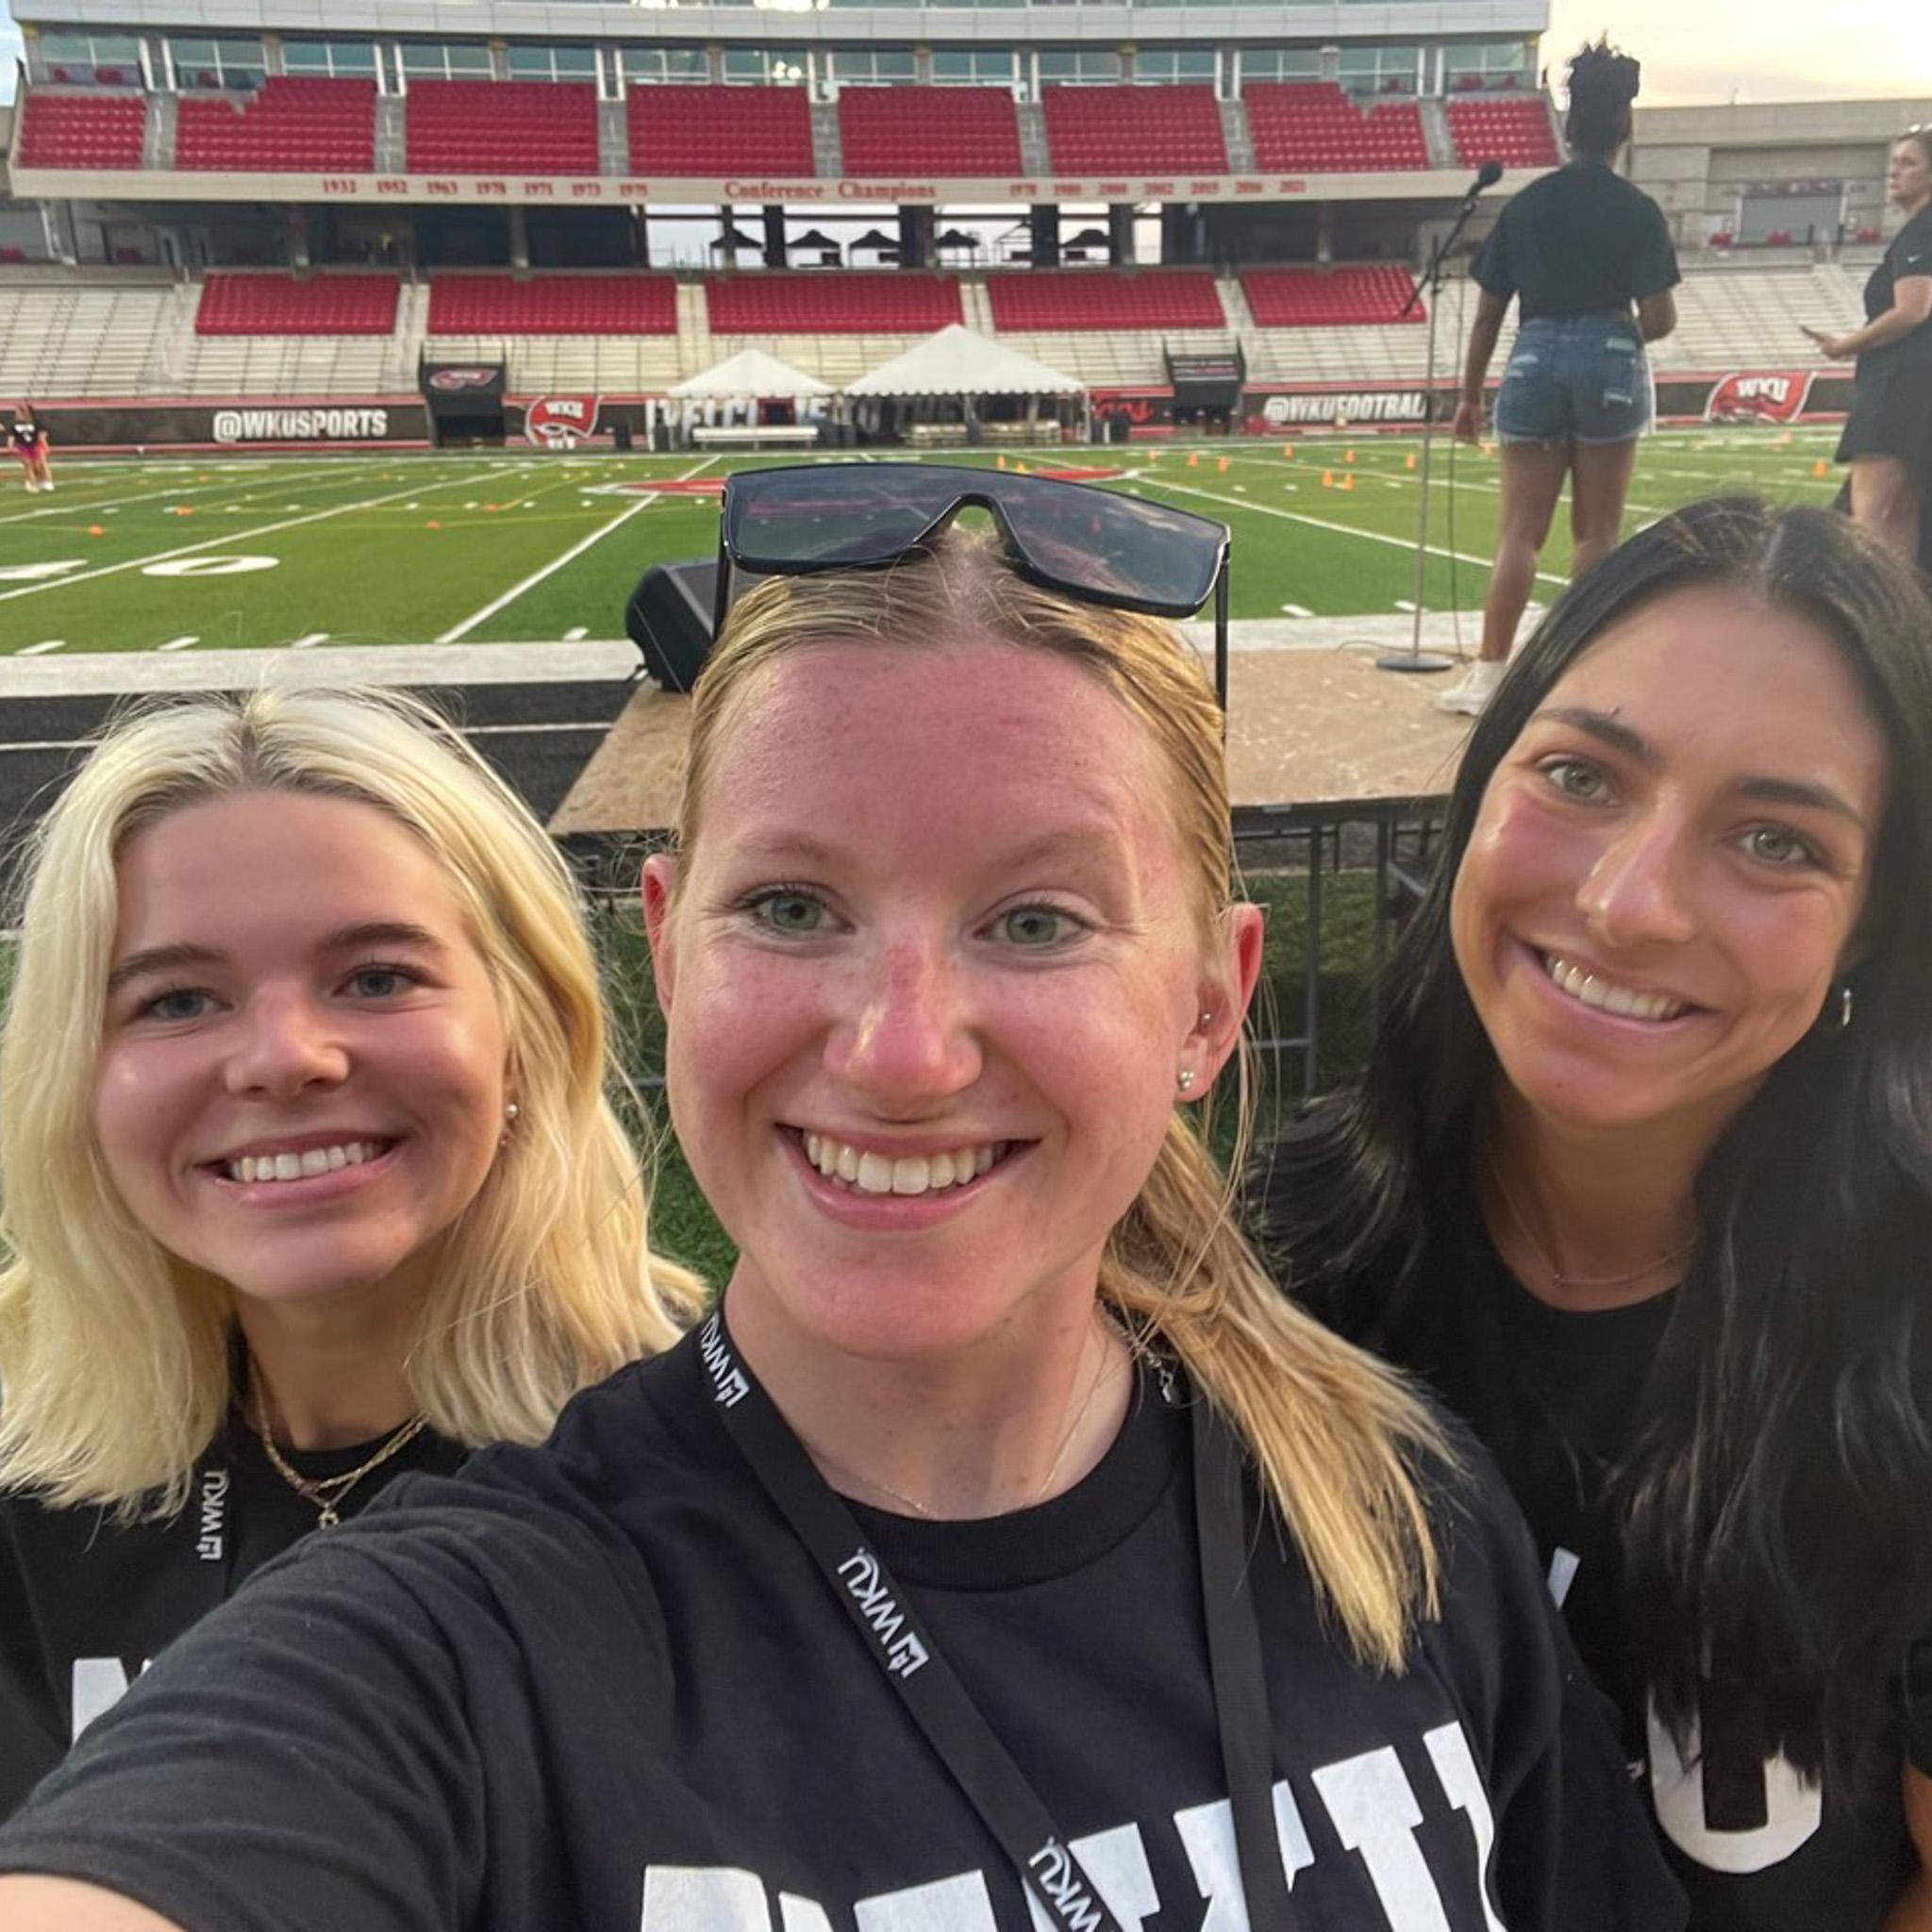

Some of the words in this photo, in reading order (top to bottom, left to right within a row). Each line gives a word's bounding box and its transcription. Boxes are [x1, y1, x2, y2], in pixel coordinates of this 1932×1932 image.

[724, 181, 824, 198] Conference
[838, 181, 937, 201] Champions
[1736, 377, 1790, 404] WKU
[213, 409, 388, 444] @WKUSPORTS
[201, 1470, 230, 1534] WKU
[837, 1546, 905, 1646] WKU
[1028, 1835, 1103, 1932] WKU
